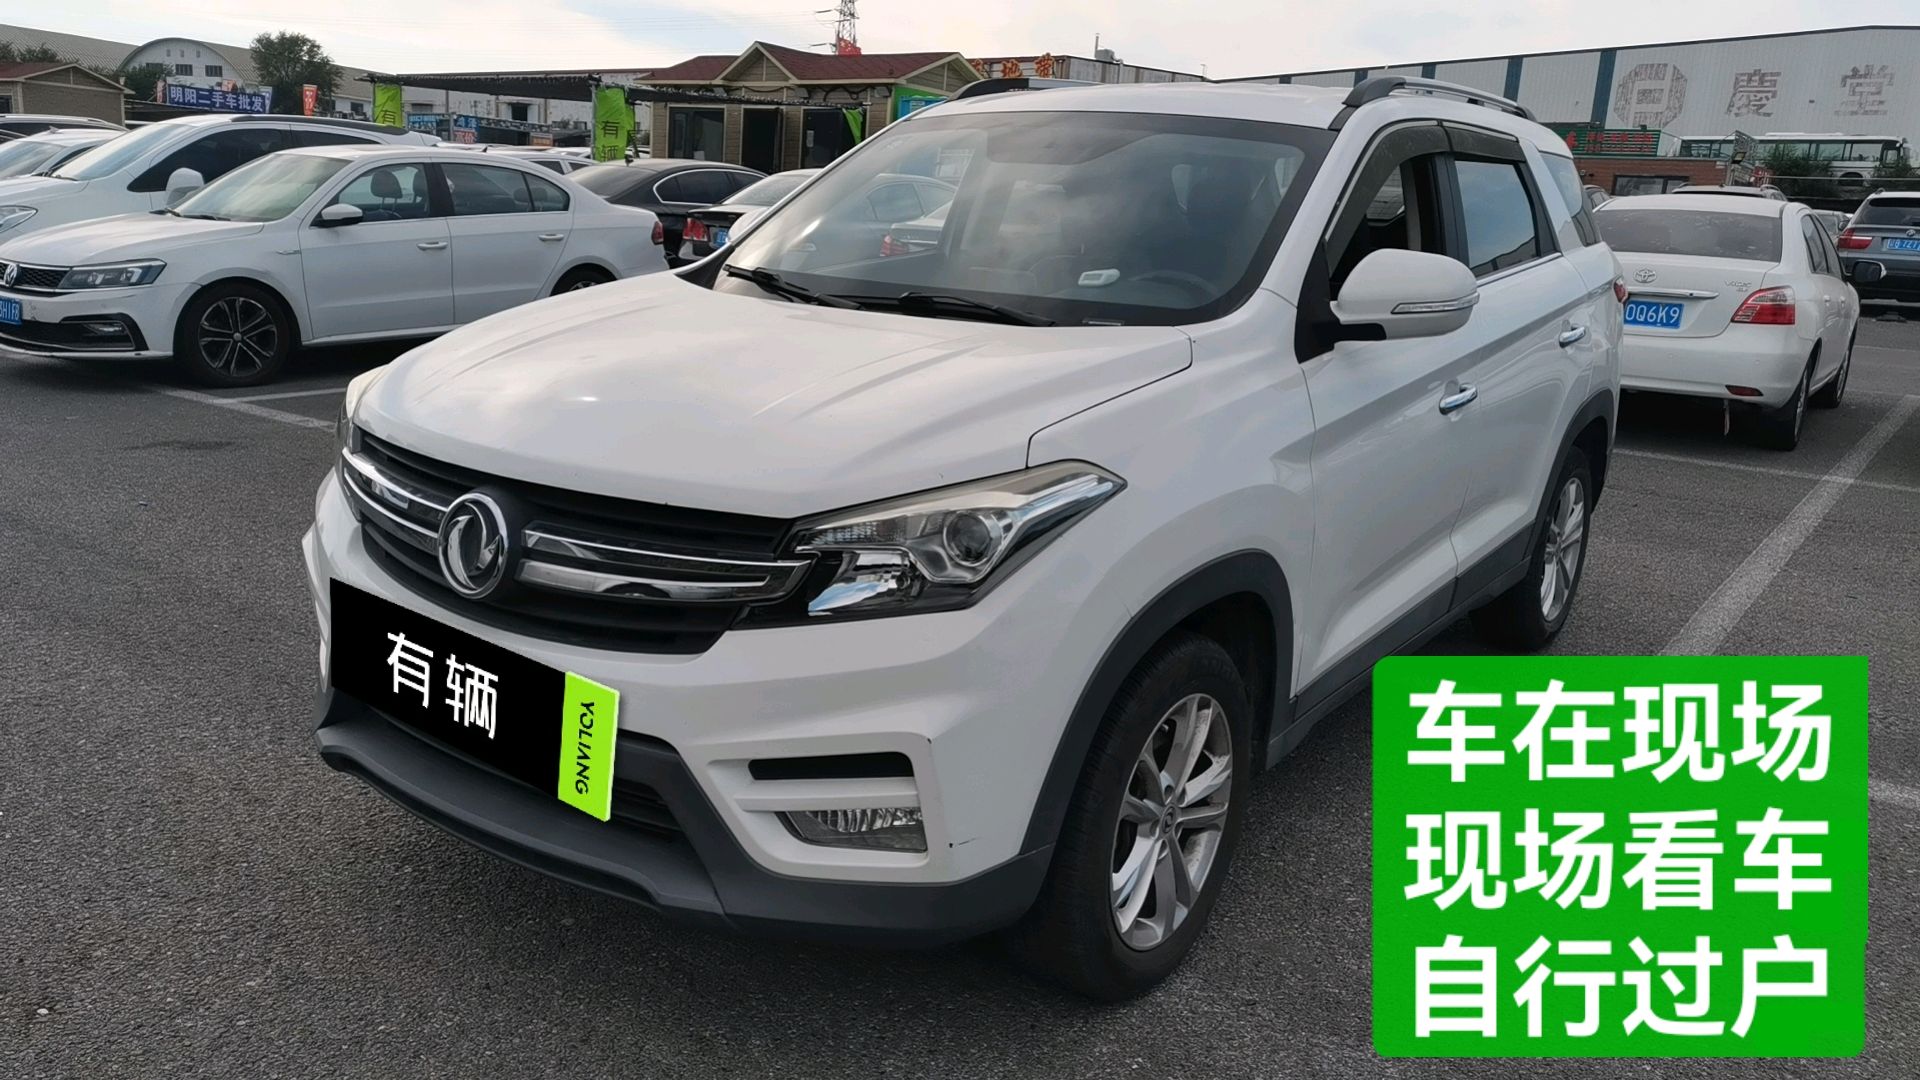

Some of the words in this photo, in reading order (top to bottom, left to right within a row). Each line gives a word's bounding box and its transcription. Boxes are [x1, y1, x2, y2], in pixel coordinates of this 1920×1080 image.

[169, 86, 264, 113] 明阳二手车批发
